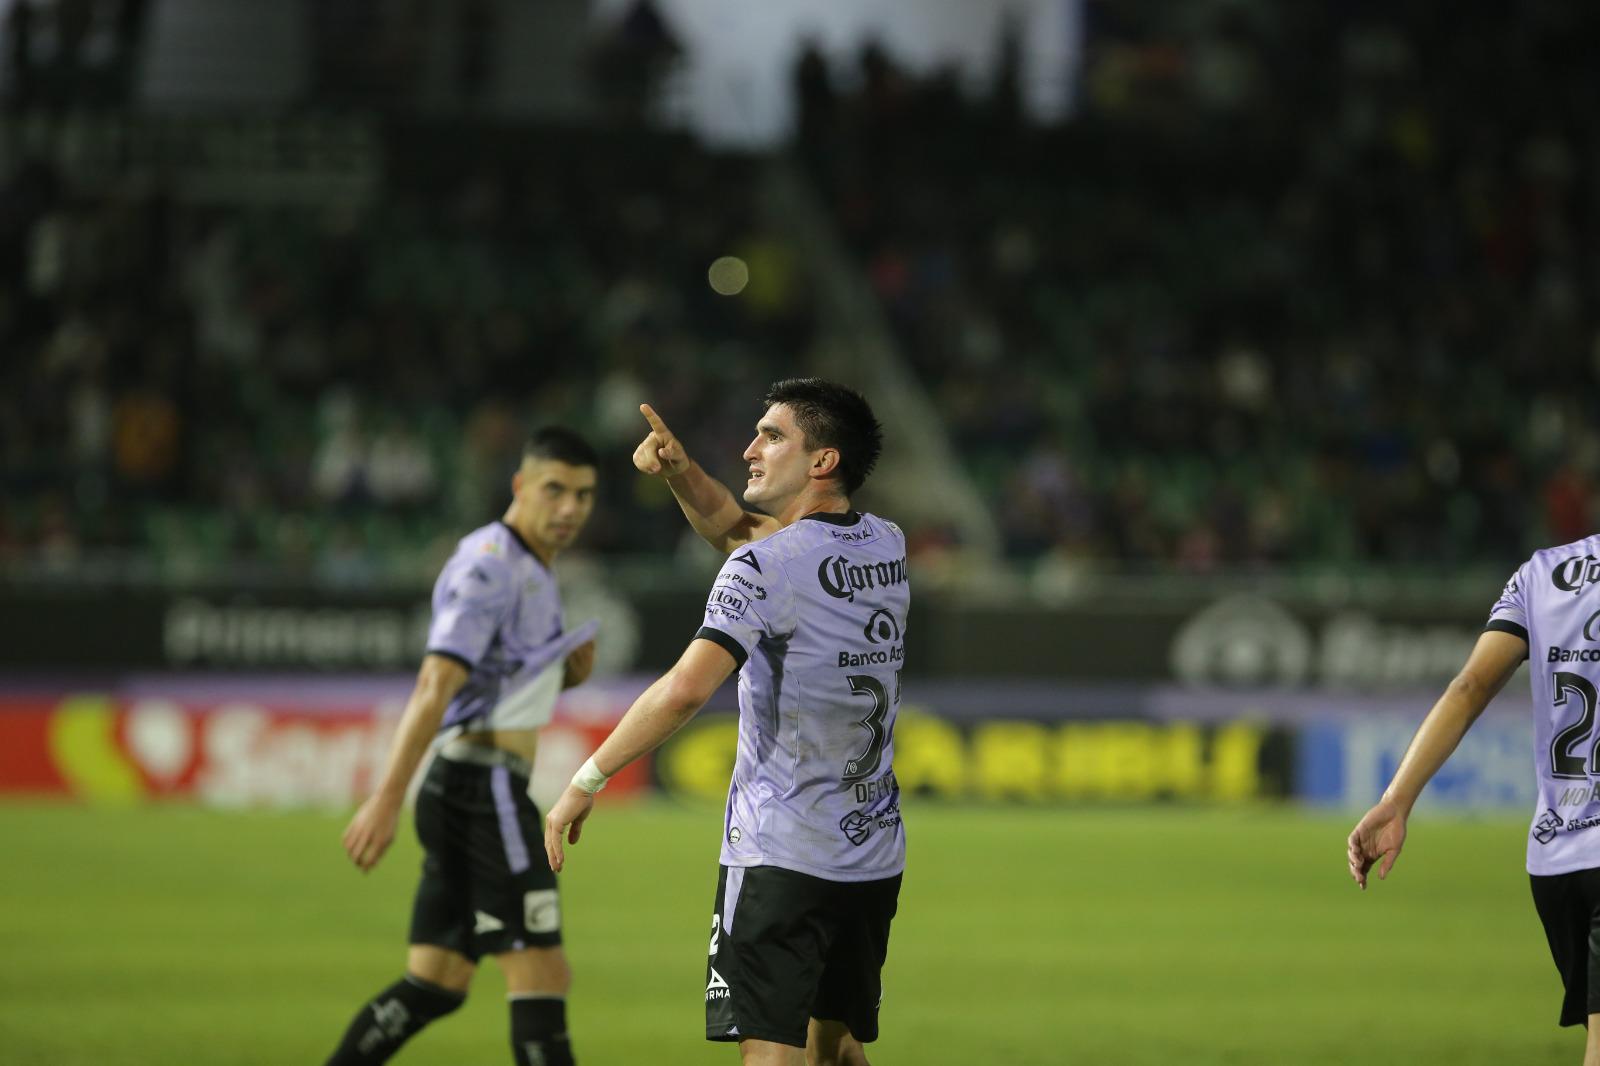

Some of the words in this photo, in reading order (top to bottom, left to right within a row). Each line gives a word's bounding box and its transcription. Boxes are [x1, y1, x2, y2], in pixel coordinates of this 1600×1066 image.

[732, 574, 754, 590] Plus
[710, 590, 743, 610] ilton
[838, 651, 887, 667] Banco
[1547, 646, 1600, 663] Banco
[705, 989, 730, 1001] IRMA
